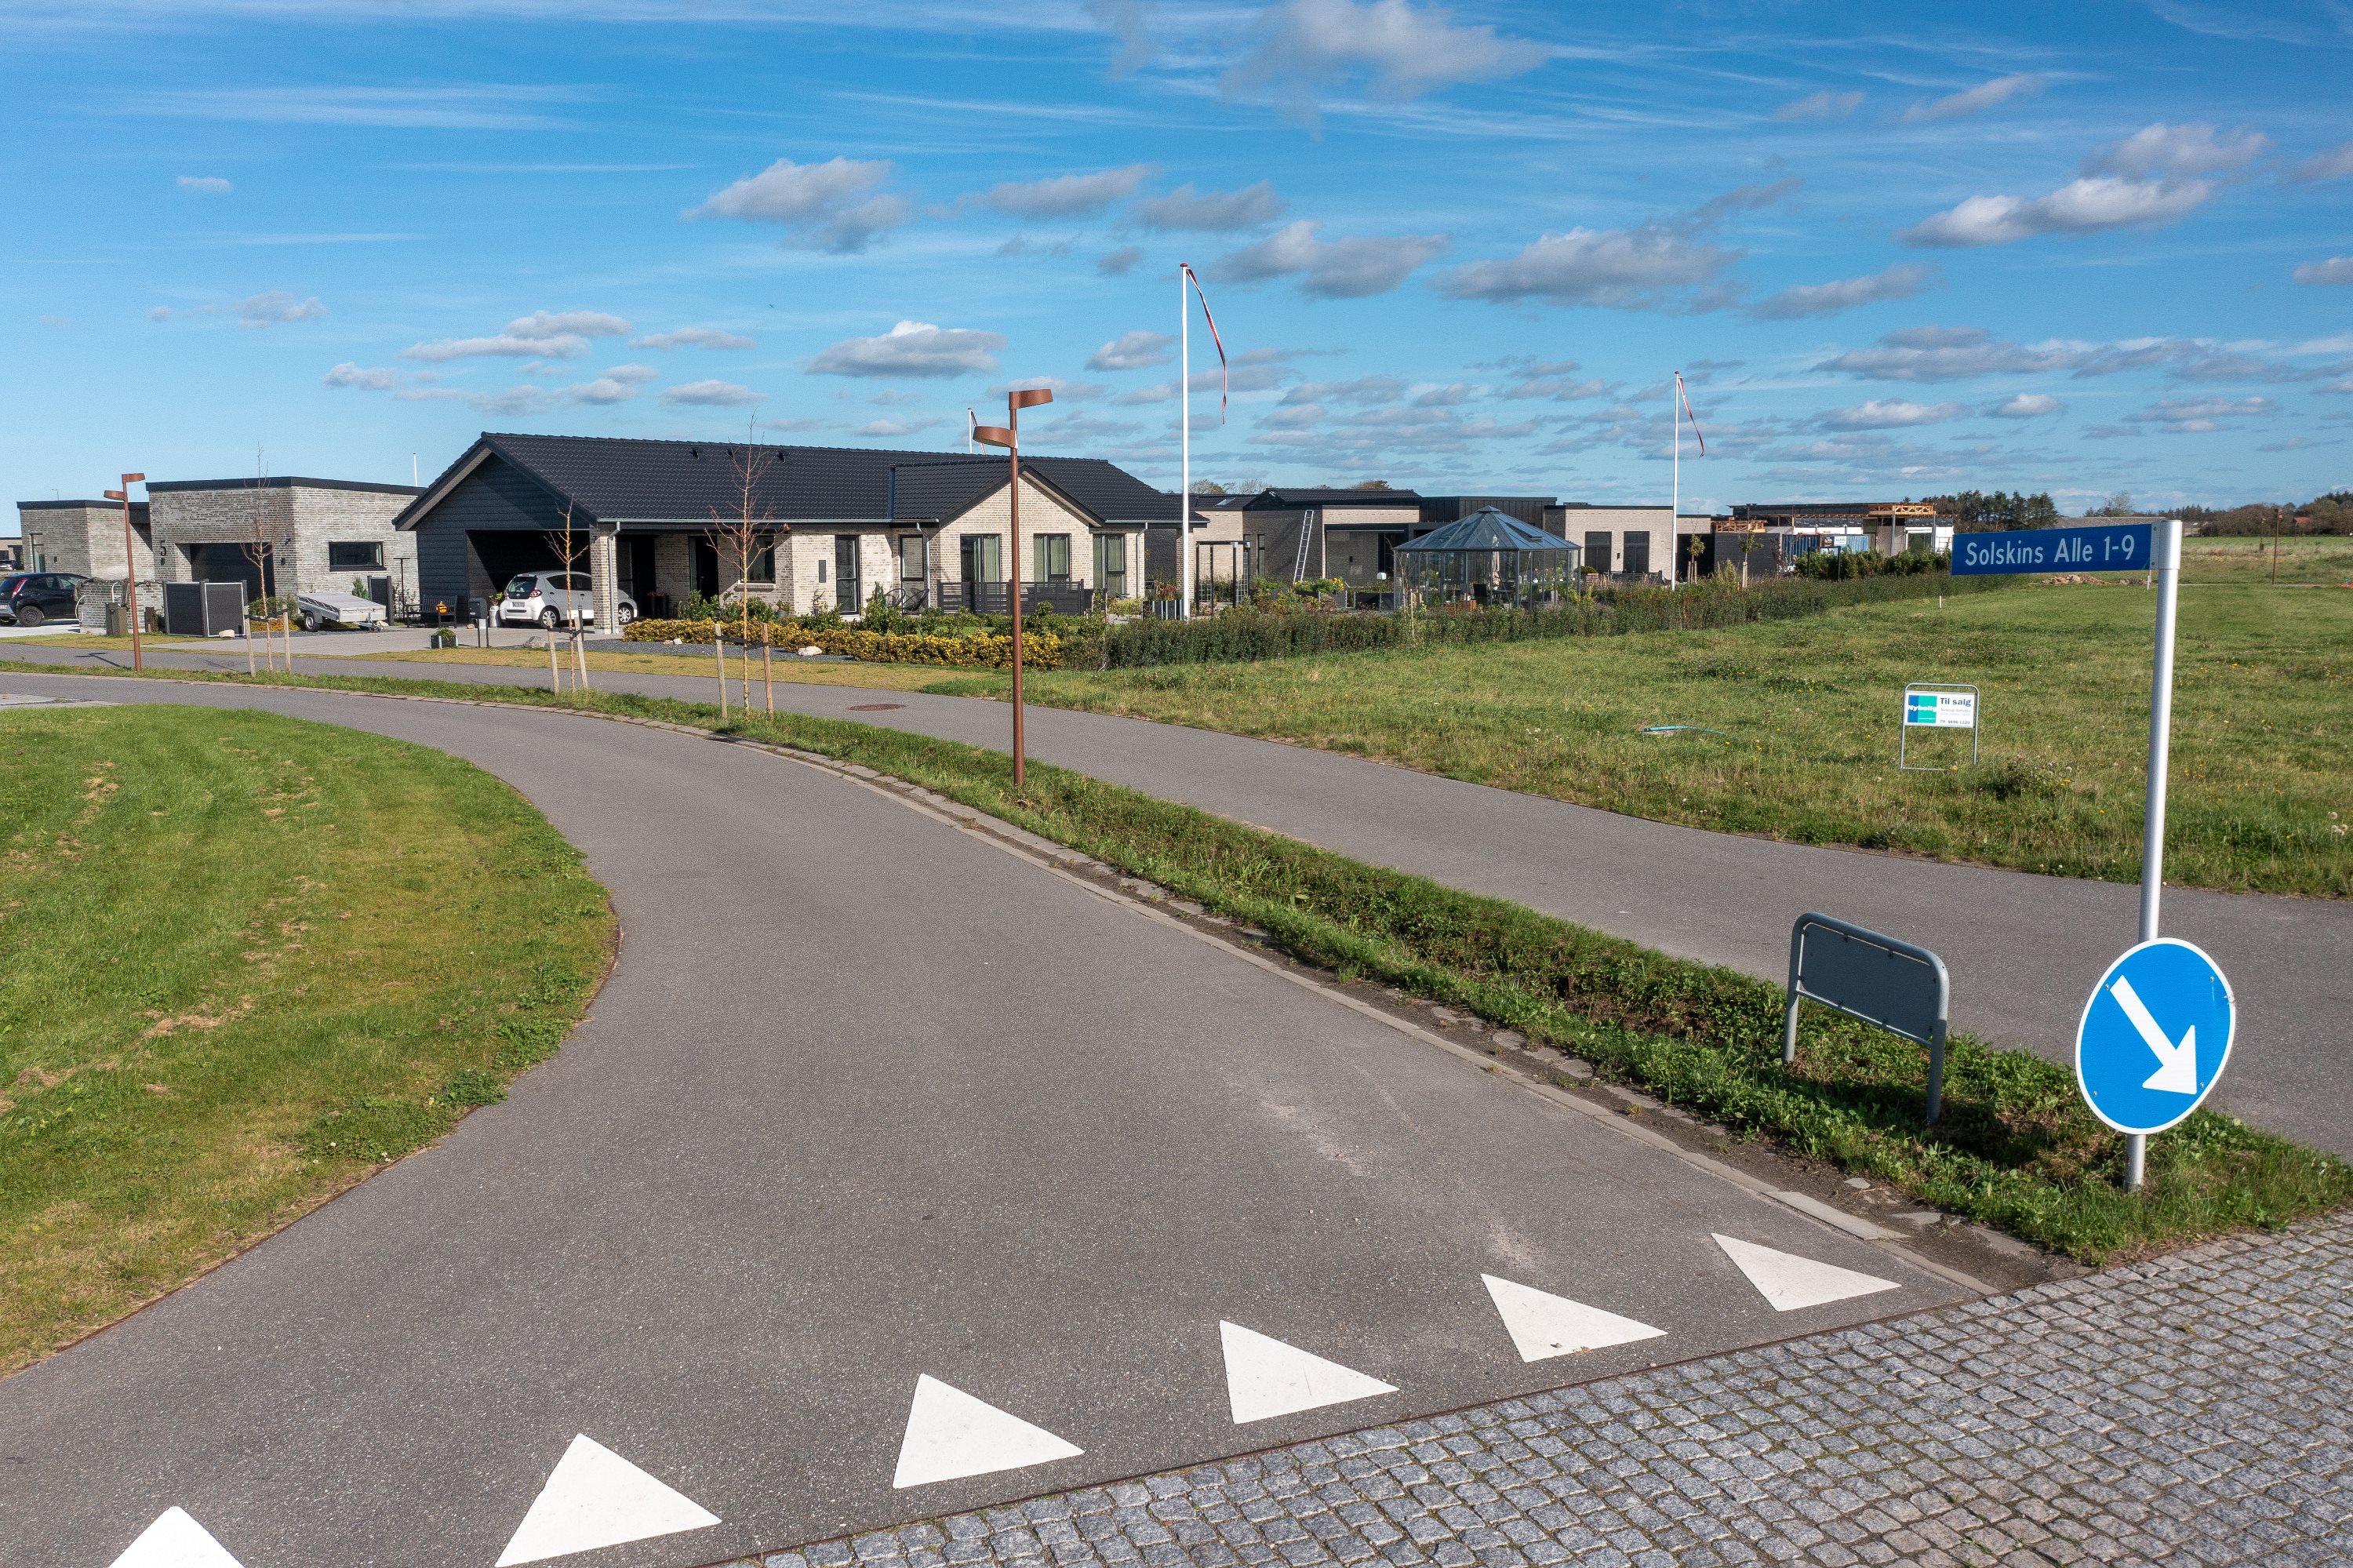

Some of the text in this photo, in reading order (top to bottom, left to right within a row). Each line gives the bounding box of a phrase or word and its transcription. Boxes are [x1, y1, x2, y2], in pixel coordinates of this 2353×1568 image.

[160, 540, 167, 557] 5
[1965, 534, 2135, 566] Solskins Alle 1-9
[1952, 698, 1972, 708] salg
